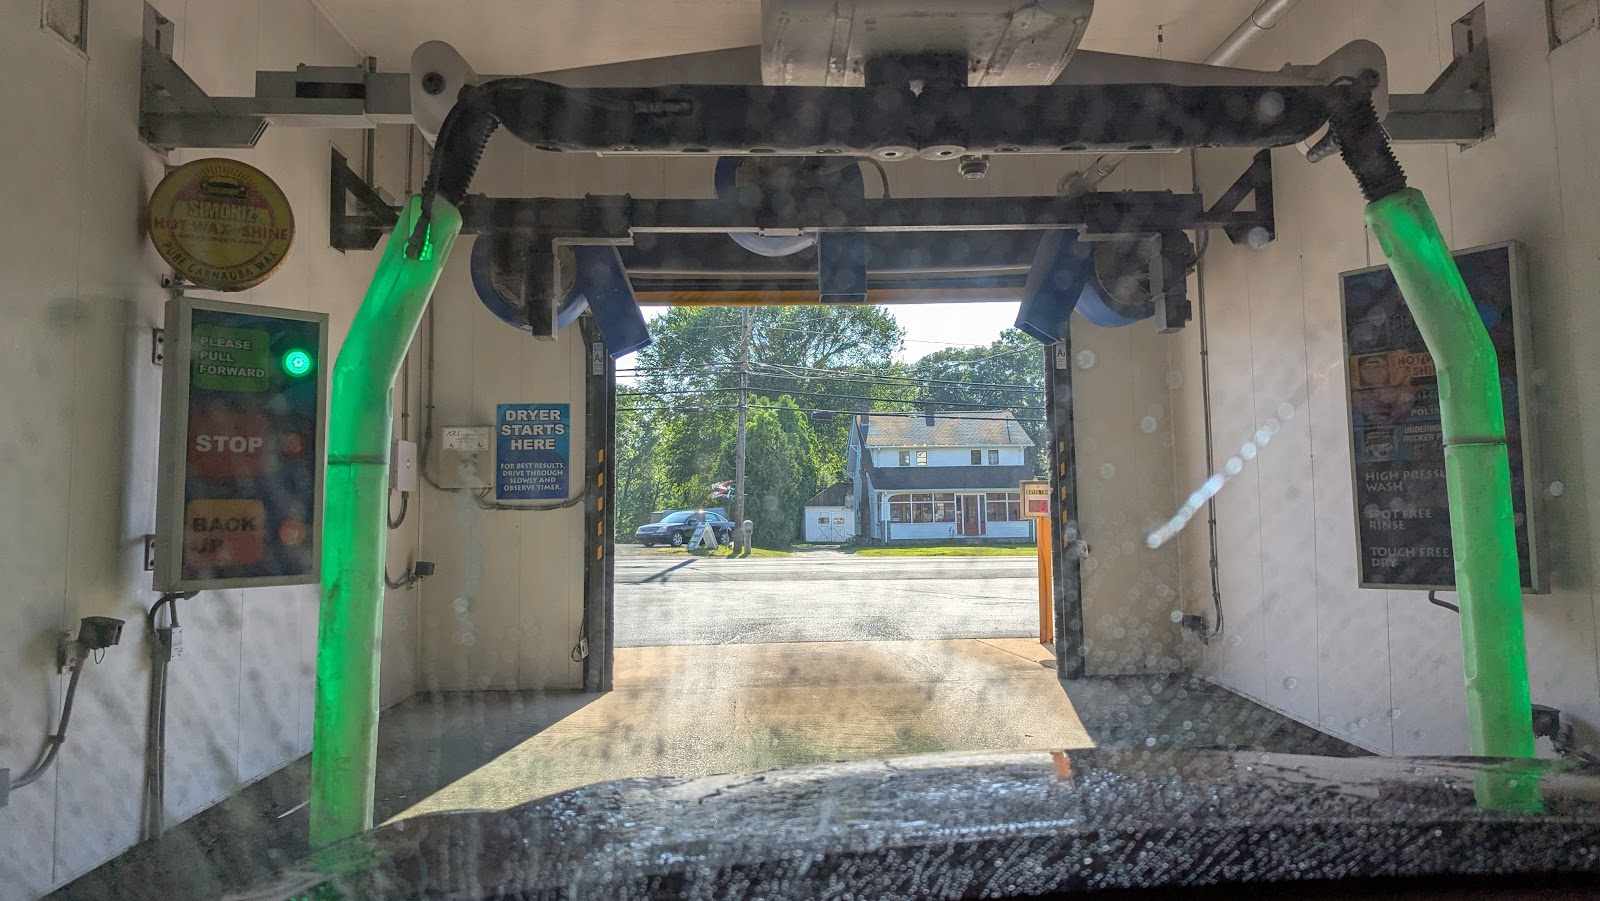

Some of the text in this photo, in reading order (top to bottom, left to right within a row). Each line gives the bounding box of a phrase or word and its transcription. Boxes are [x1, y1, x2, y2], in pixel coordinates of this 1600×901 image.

[187, 200, 258, 223] SIMONIZ
[153, 216, 288, 240] HOT WAX SHINE
[162, 241, 278, 281] PURE CARNAUBA WAX
[199, 336, 252, 350] PLEASE
[199, 350, 234, 362] PULL
[1397, 353, 1420, 366] HOT
[199, 364, 265, 378] FORWARD
[1412, 365, 1435, 376] SHI
[505, 409, 561, 421] DRYER
[1411, 407, 1440, 417] POLIS
[501, 424, 565, 436] STARTS
[1404, 424, 1442, 434] UNDERBO
[195, 434, 263, 453] STOP
[510, 438, 556, 451] HERE
[1403, 434, 1435, 443] ROCKER
[1365, 469, 1446, 481] HIGH PRESSU
[1365, 480, 1403, 492] WASH
[1368, 508, 1433, 519] SPOT FREE
[1369, 520, 1406, 531] RINSE
[1369, 546, 1449, 558] TOUCH FREE
[1371, 557, 1398, 567] DRY
